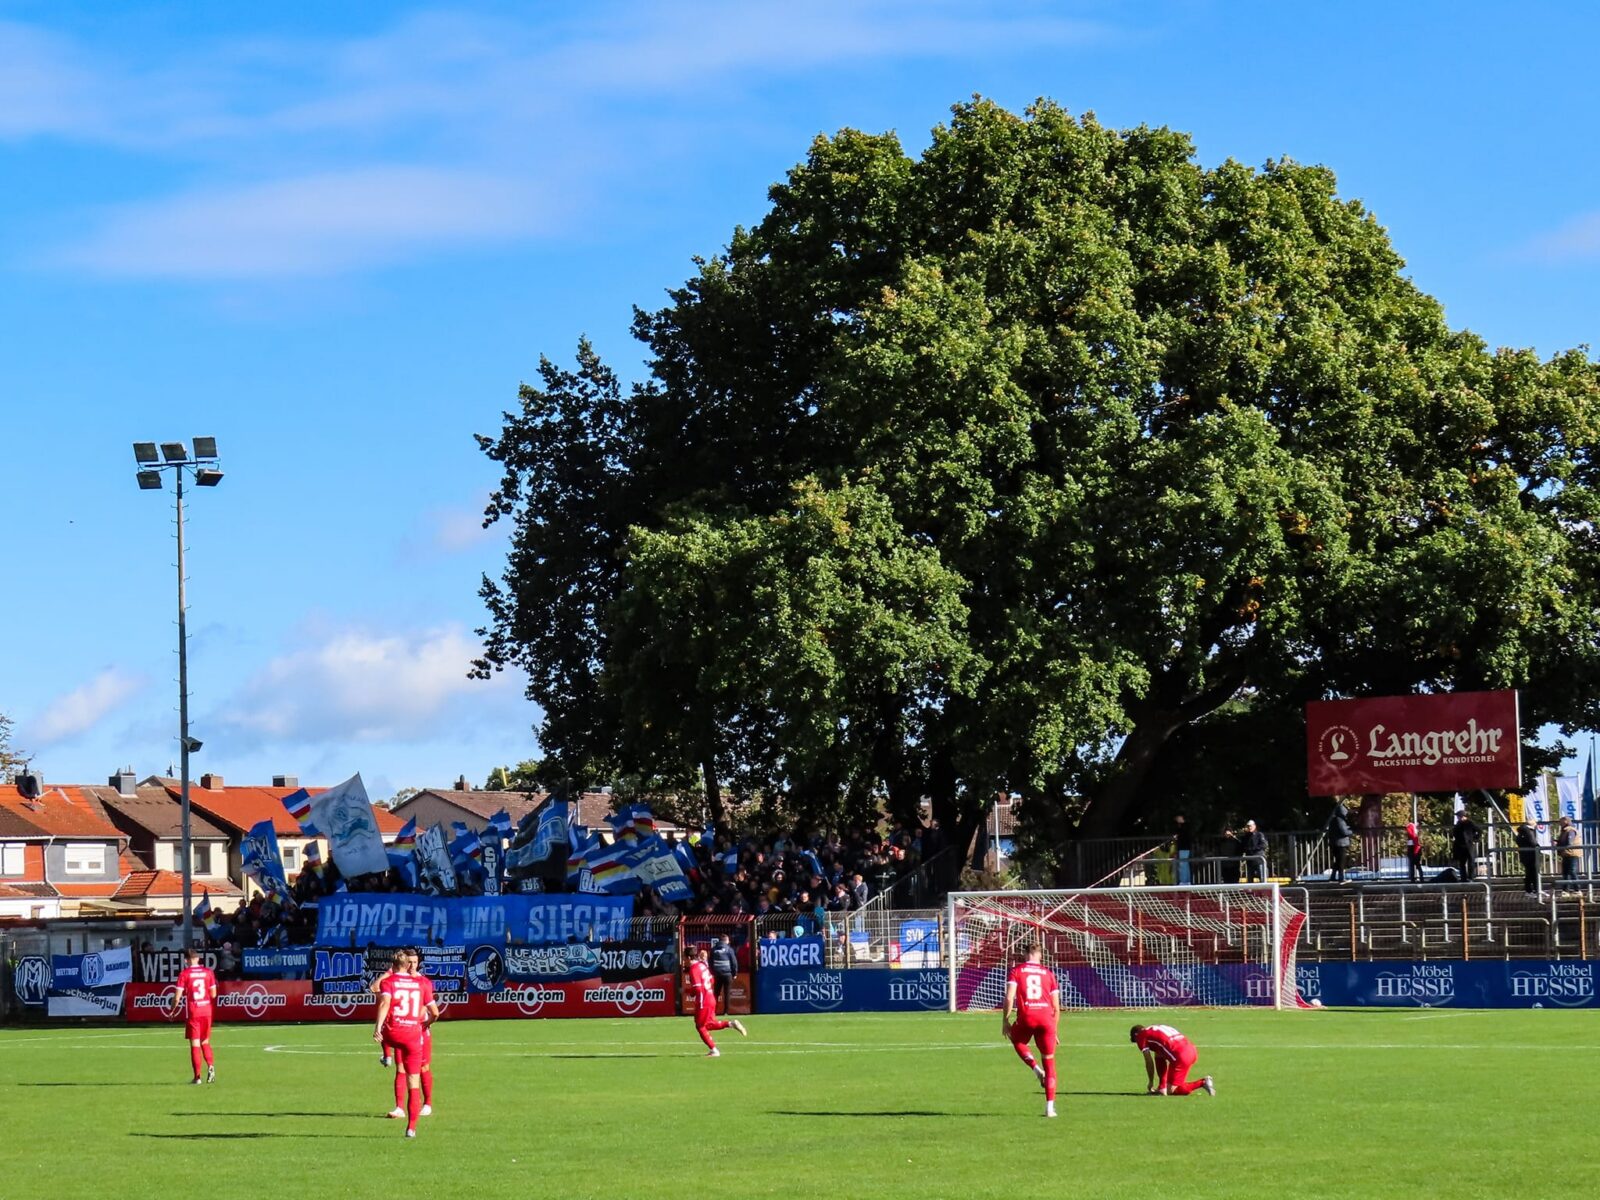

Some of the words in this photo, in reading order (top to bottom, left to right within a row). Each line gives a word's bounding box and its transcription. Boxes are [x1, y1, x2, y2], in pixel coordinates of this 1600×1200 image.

[1367, 718, 1503, 765] Langrehr
[1373, 758, 1421, 767] BACKSTUBE
[1443, 755, 1496, 765] KONDITOREI
[322, 899, 448, 939] KÄMPFEN
[463, 905, 505, 939] UND
[528, 903, 625, 942] SIEGEN
[244, 955, 269, 968] FUSEL
[282, 954, 307, 967] TOWN
[760, 939, 822, 968] BÖRGER
[505, 958, 569, 974] REBELS
[1296, 966, 1319, 979] öbel
[1412, 965, 1453, 977] Möbel
[1550, 964, 1592, 977] Möbel
[809, 972, 842, 984] Möbel
[919, 971, 949, 983] Möbe
[193, 979, 206, 1001] 3
[323, 981, 361, 992] ULTRA
[780, 983, 843, 1001] HESSE
[1026, 975, 1042, 1000] 8
[1124, 980, 1193, 998] HESSE
[1375, 977, 1455, 997] HESSE
[1511, 976, 1594, 997] HESSE
[393, 989, 421, 1018] 31
